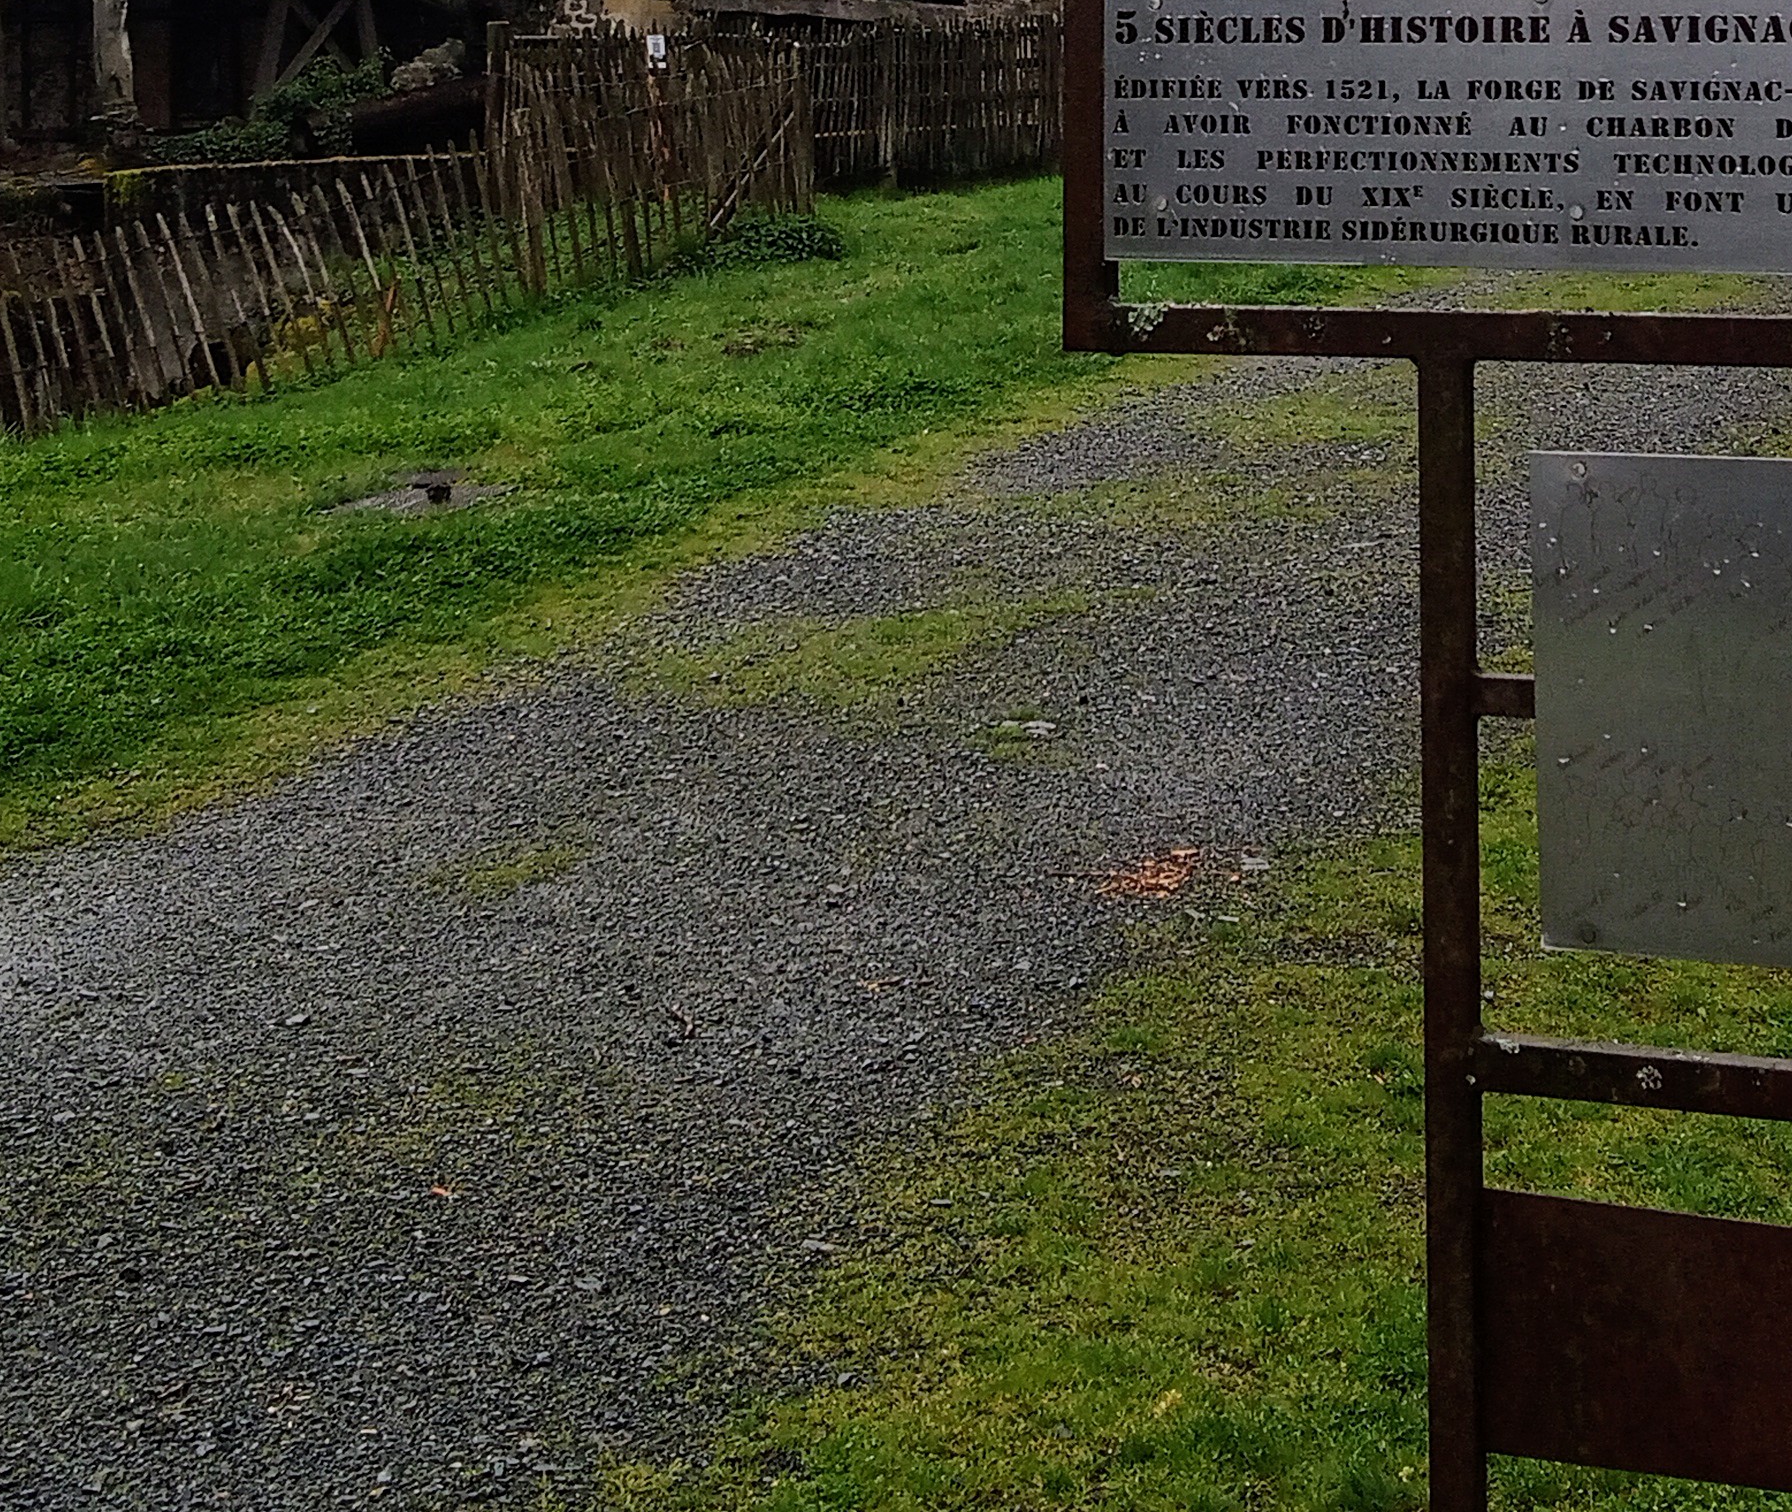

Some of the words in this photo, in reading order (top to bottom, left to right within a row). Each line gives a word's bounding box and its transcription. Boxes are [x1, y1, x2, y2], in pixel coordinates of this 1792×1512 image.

[1114, 9, 1138, 45] 5
[1154, 10, 1307, 45] SIÈCLES
[1564, 9, 1594, 45] À
[1112, 73, 1222, 99] ÉDIFIÉE
[1234, 78, 1308, 100] VERS
[1324, 78, 1400, 103] 1521,
[1416, 78, 1451, 101] LA
[1465, 79, 1562, 101] FORGE
[1576, 79, 1615, 102] DE
[1111, 108, 1130, 133] À
[1162, 112, 1251, 134] AVOIR
[1285, 109, 1472, 136] FONCTIONNÉ
[1507, 115, 1548, 137] AU
[1584, 116, 1735, 139] CHARBON
[1112, 147, 1147, 168] ET
[1175, 147, 1225, 169] LES
[1254, 148, 1579, 174] PERFECTIONNEMENTS
[1111, 181, 1148, 203] AU
[1175, 182, 1267, 205] COURS
[1294, 184, 1333, 207] DU
[1450, 182, 1565, 214] SIÈCLE,
[1596, 189, 1635, 212] EN
[1664, 190, 1745, 214] FONT
[1112, 215, 1146, 237] DE
[1340, 215, 1560, 245] SIDÉRURGIQUE
[1570, 223, 1699, 248] RURALE.
